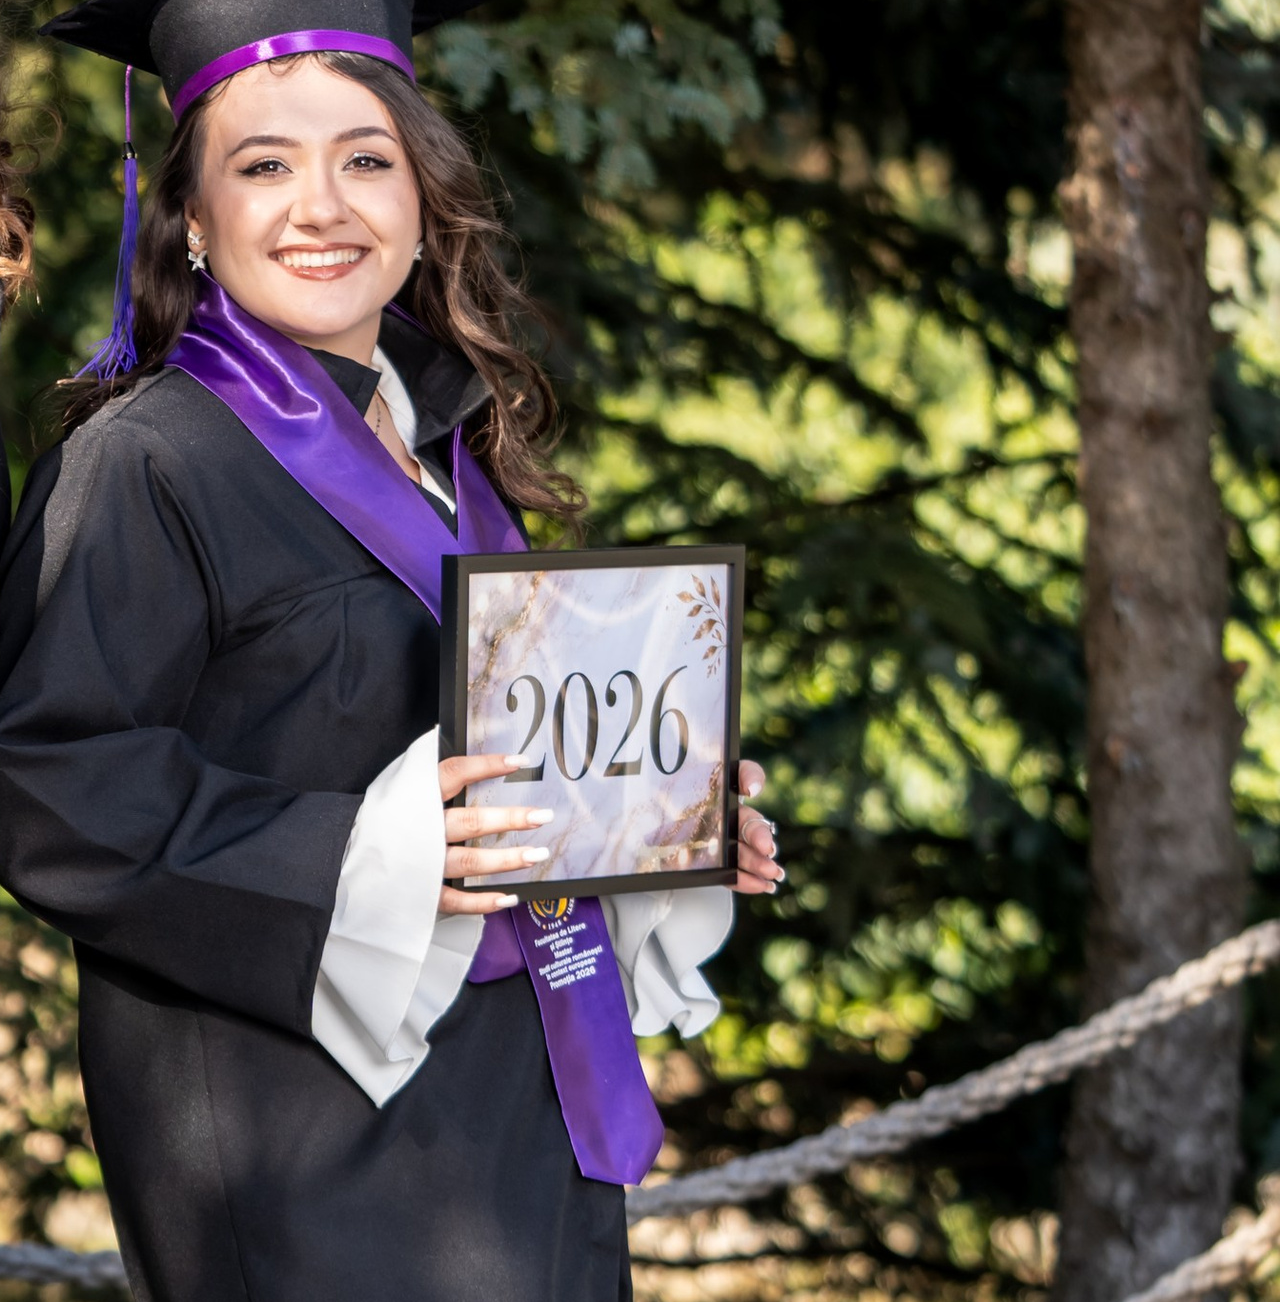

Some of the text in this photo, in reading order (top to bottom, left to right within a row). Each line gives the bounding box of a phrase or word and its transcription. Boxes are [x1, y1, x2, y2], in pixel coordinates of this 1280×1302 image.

[503, 665, 689, 783] 2026
[559, 929, 568, 937] de
[567, 922, 587, 934] Litere
[554, 947, 573, 959] Master
[568, 957, 596, 971] european
[575, 965, 596, 980] 2026
